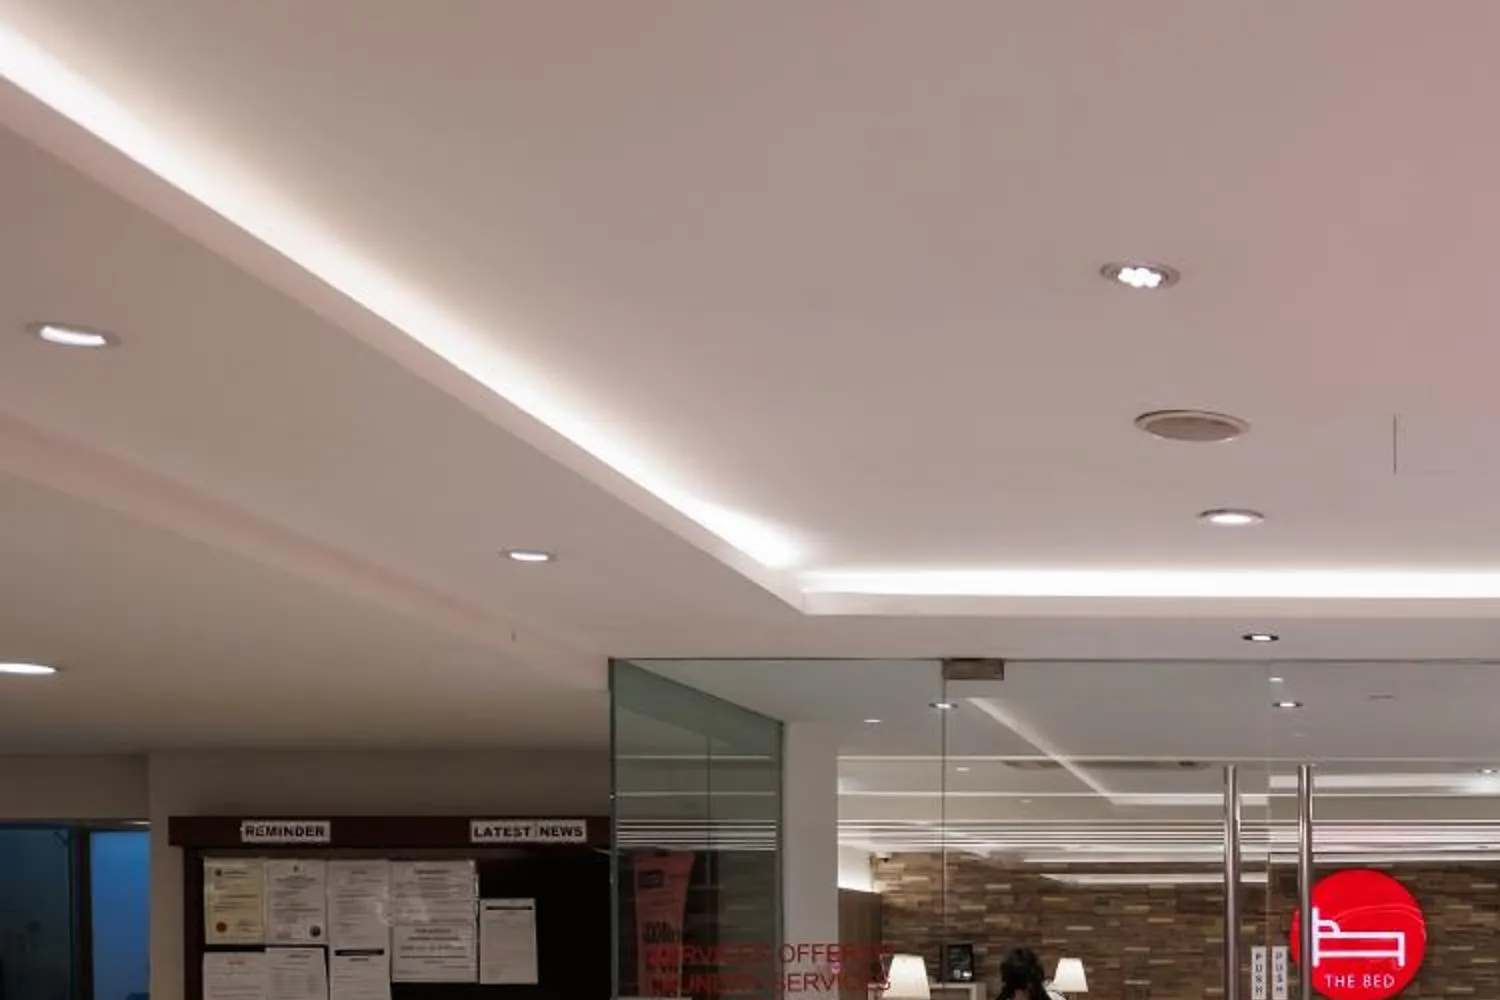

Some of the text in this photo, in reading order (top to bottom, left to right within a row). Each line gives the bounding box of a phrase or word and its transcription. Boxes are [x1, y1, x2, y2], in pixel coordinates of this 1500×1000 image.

[245, 824, 326, 838] REMINDER
[473, 824, 584, 839] LATEST NEWS
[1255, 952, 1264, 994] PUSH
[1275, 951, 1284, 993] PUSH
[1324, 974, 1396, 989] THE BED
